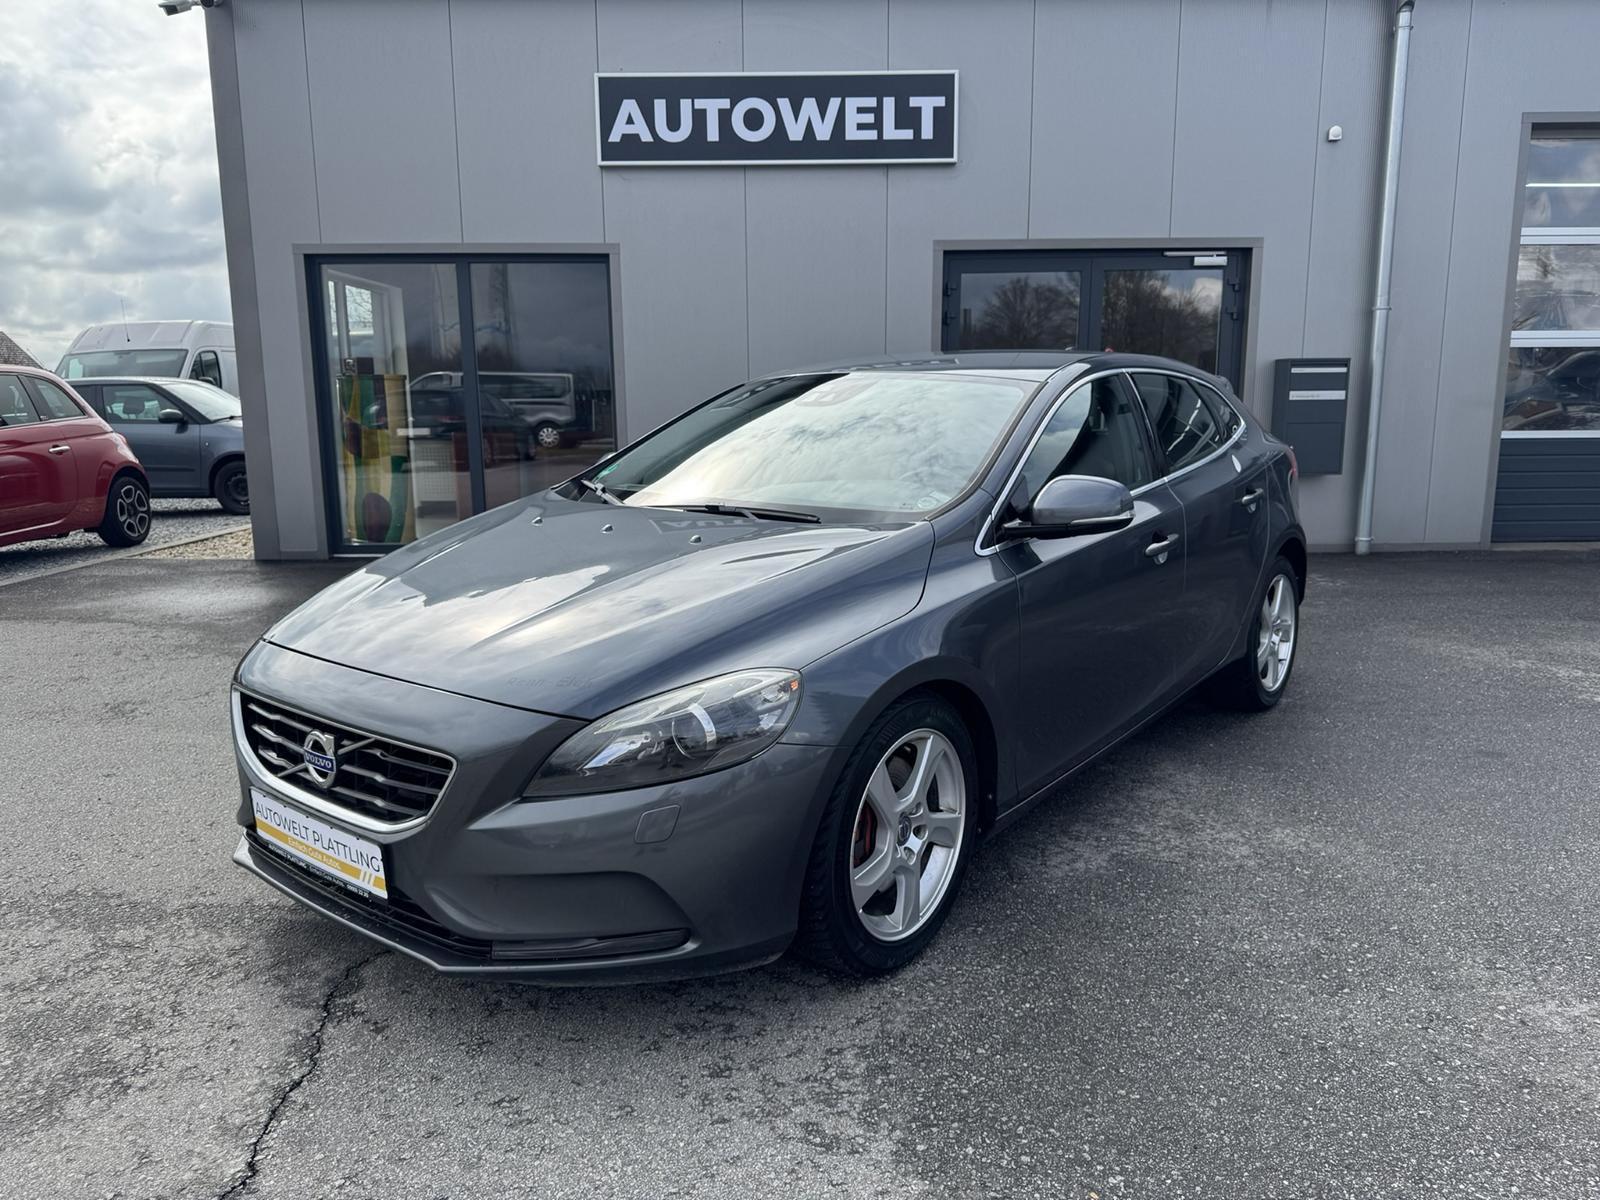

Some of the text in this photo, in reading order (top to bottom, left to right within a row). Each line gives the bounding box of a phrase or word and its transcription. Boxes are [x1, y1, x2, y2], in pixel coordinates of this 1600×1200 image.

[608, 96, 946, 143] AUTOWELT
[305, 752, 332, 769] VOLVO
[255, 802, 380, 873] AUTOWELT PLATTLING
